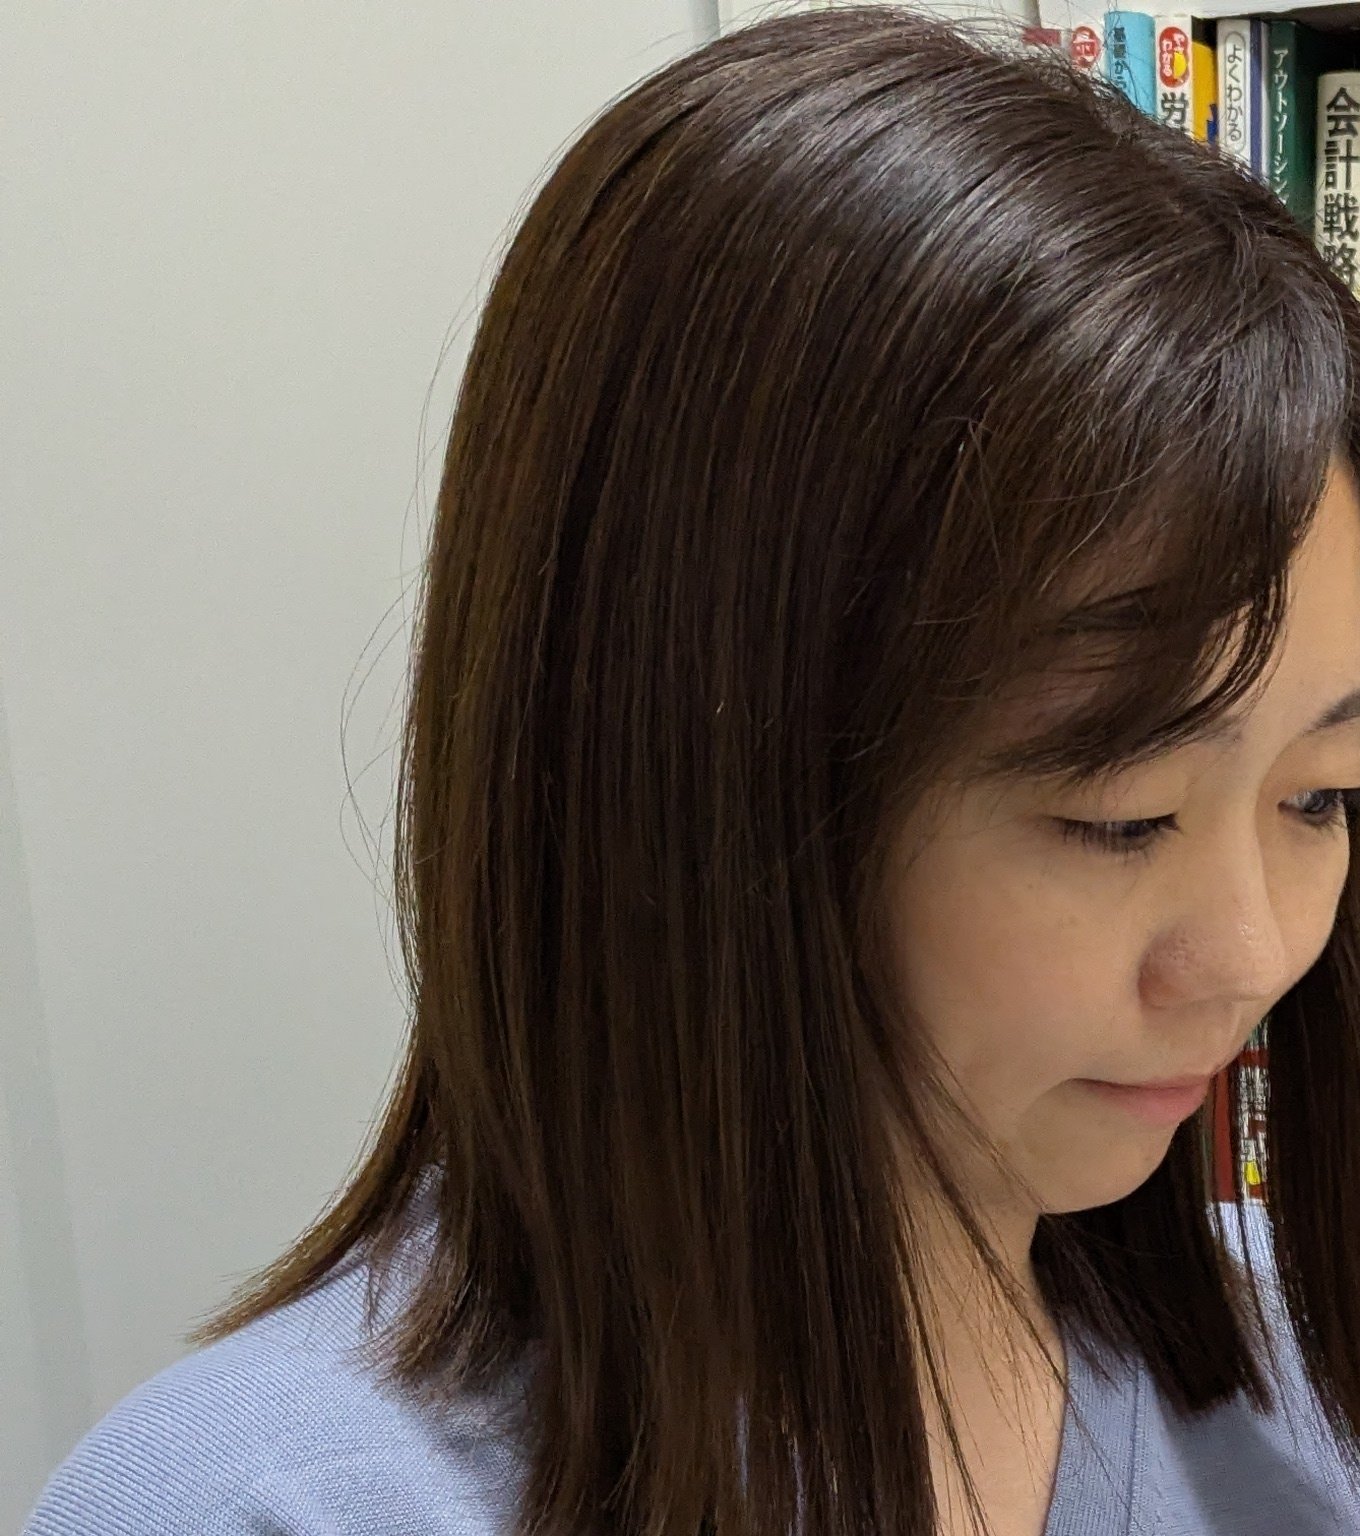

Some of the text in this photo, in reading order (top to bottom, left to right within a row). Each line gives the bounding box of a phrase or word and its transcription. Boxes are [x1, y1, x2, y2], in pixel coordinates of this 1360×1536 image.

[1227, 43, 1245, 142] よくわかる
[1323, 86, 1360, 288] 会計戦略
